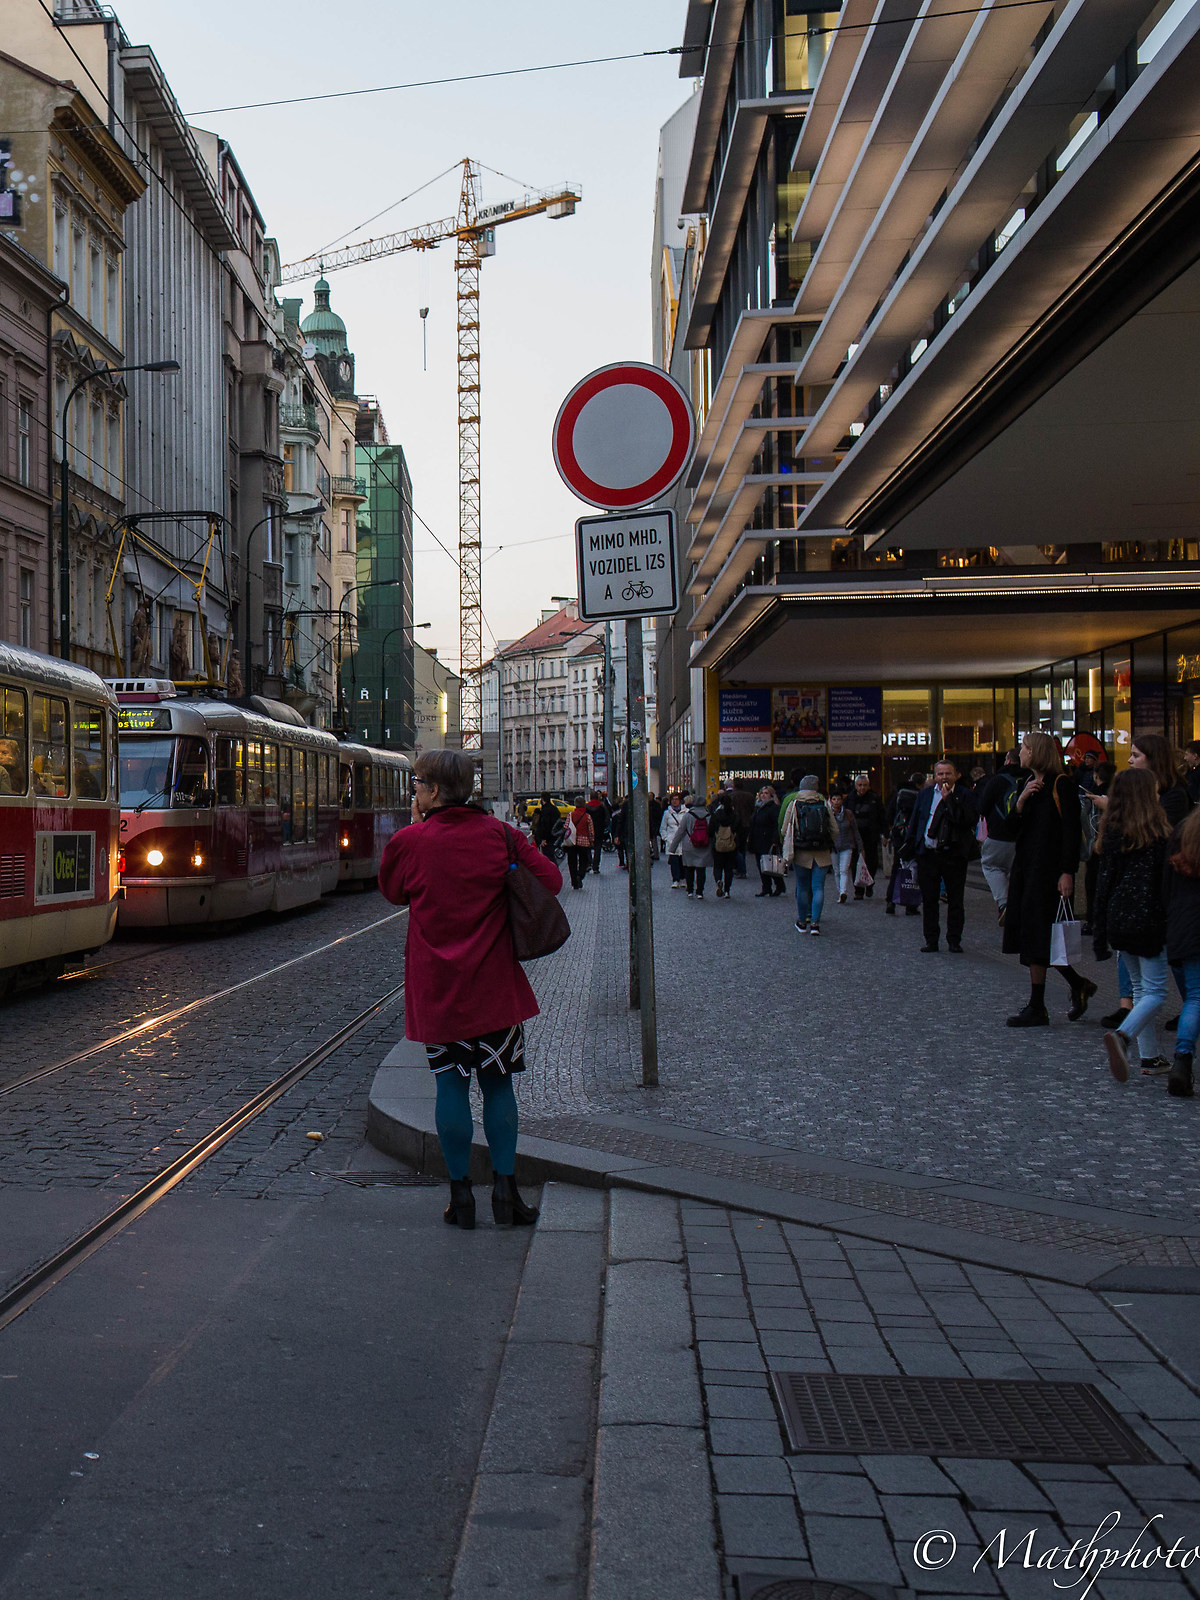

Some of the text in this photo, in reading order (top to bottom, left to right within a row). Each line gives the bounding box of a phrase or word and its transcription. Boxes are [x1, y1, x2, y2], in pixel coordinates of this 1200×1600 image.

[478, 201, 515, 220] KRANIMEX
[590, 528, 662, 551] MIMO MHD,
[589, 553, 665, 577] VOZIDEL IZS
[604, 584, 613, 600] A
[117, 718, 155, 728] ostivař
[56, 850, 75, 880] Otec
